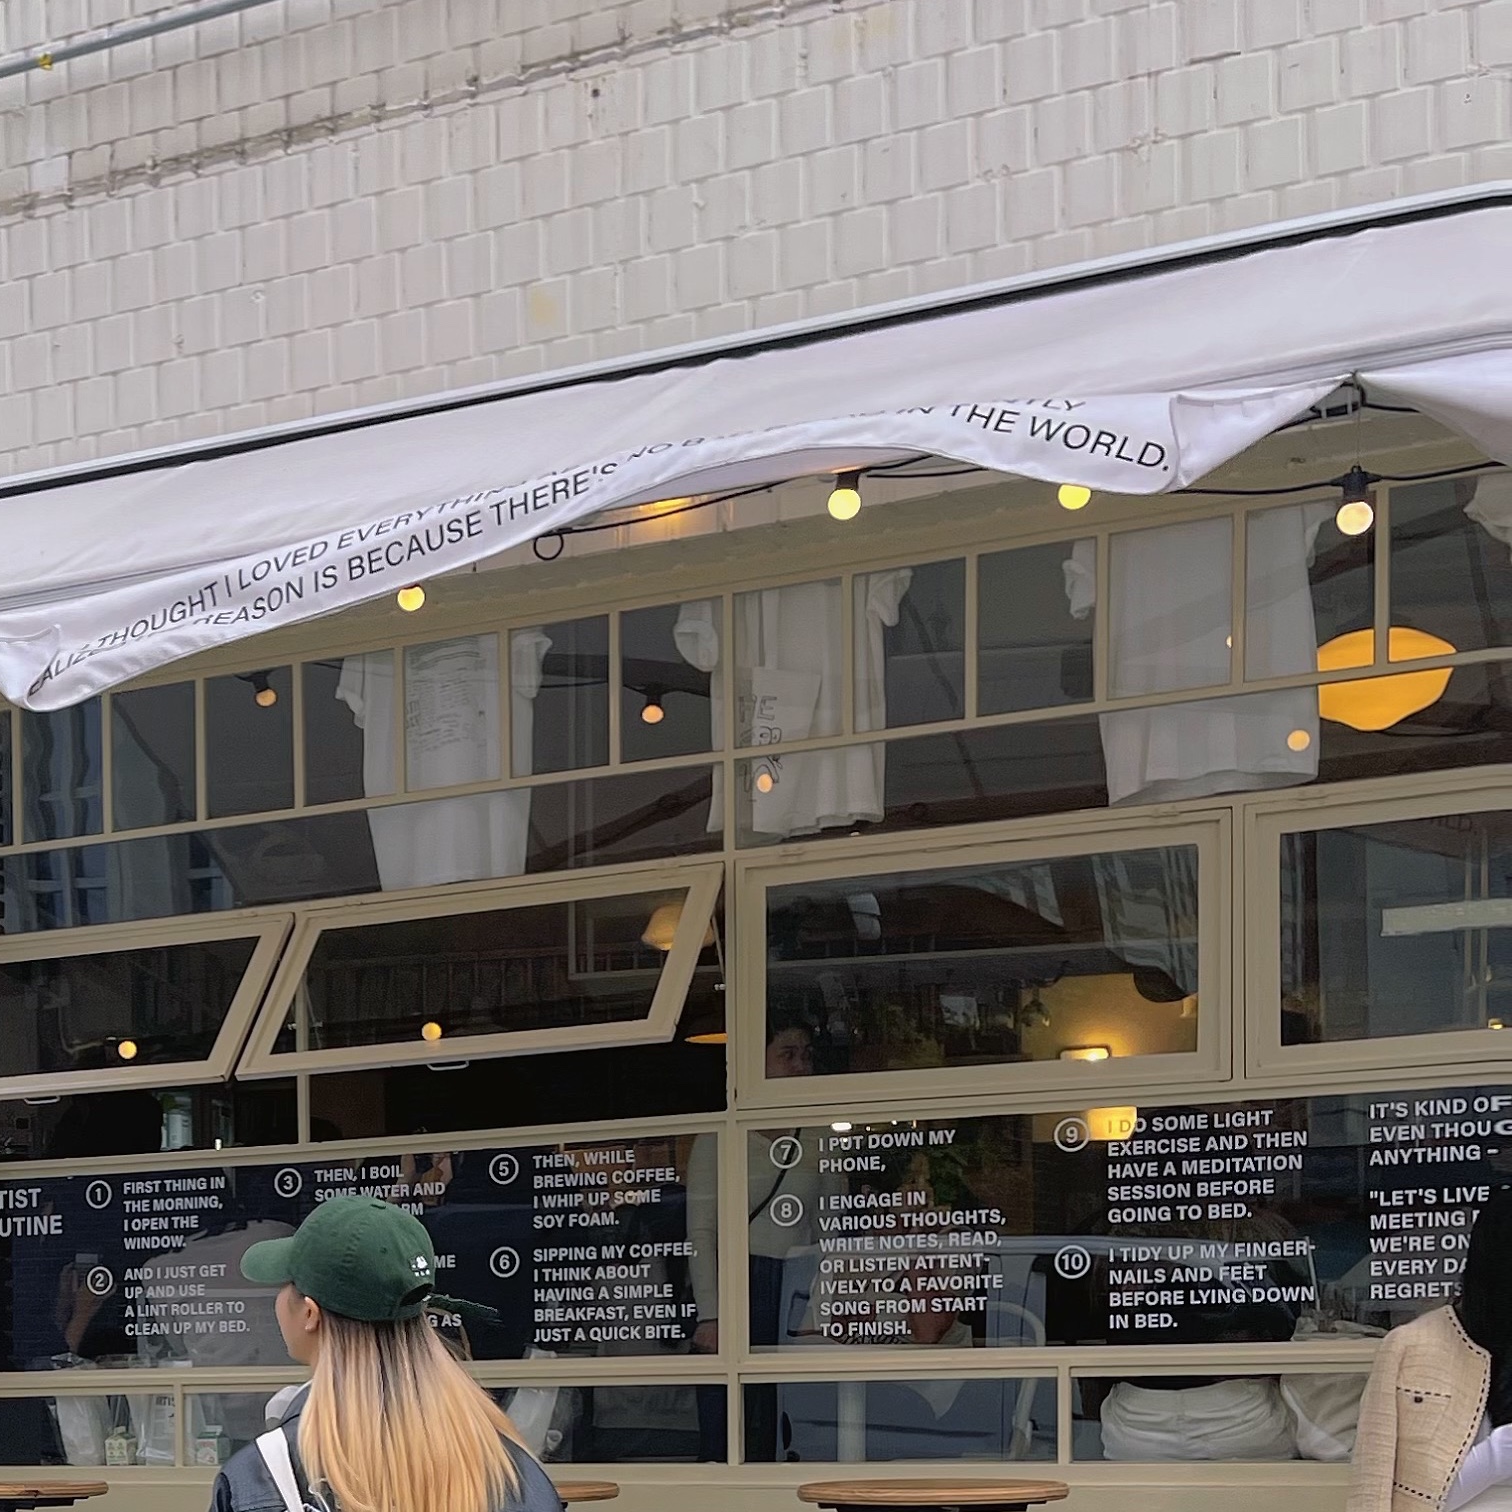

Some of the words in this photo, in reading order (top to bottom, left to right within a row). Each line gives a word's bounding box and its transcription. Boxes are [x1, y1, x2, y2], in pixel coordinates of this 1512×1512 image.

[193, 576, 304, 625] EASON
[314, 565, 338, 593] IS
[348, 510, 483, 582] BECAUSE
[949, 403, 1021, 434] THE
[1029, 415, 1169, 471] WORLD.
[97, 581, 218, 648] THOUGHT
[224, 574, 233, 598] I
[238, 540, 328, 590] LOVED
[1370, 1102, 1408, 1119] IT'S
[1415, 1099, 1467, 1117] KIND
[1473, 1095, 1512, 1112] OF
[1108, 1120, 1112, 1133] I
[1119, 1118, 1146, 1132] DO
[1152, 1115, 1208, 1131] SOME
[1214, 1110, 1273, 1128] LIGHT
[819, 1138, 823, 1151] I
[829, 1136, 863, 1150] PUT
[868, 1133, 924, 1148] DOWN
[929, 1130, 955, 1145] MY
[1370, 1124, 1425, 1143] EVEN
[1108, 1137, 1200, 1156] EXERCISE
[1205, 1135, 1248, 1151] AND
[1253, 1131, 1307, 1149] THEN
[532, 1153, 580, 1169] THEN,
[585, 1150, 635, 1166] WHILE
[819, 1156, 886, 1172] PHONE,
[1370, 1145, 1481, 1166] ANYTHING
[314, 1168, 358, 1182] THEN,
[362, 1167, 366, 1179] I
[370, 1165, 404, 1178] BOIL
[1108, 1162, 1158, 1179] HAVE
[1163, 1161, 1176, 1176] A
[1181, 1154, 1303, 1175] MEDITATION
[124, 1180, 161, 1195] FIRST
[164, 1178, 207, 1192] THING
[210, 1176, 225, 1189] IN
[534, 1172, 607, 1189] BREWING
[612, 1168, 680, 1183] COFFEE,
[360, 1184, 409, 1198] WATER
[414, 1182, 445, 1196] AND
[534, 1196, 538, 1208] I
[542, 1194, 583, 1208] WHIP
[588, 1192, 610, 1205] UP
[614, 1189, 661, 1204] SOME
[1108, 1183, 1191, 1201] SESSION
[1197, 1179, 1274, 1197] BEFORE
[1370, 1188, 1437, 1206] "LET'S
[1443, 1186, 1489, 1203] LIVE
[124, 1200, 150, 1213] THE
[153, 1196, 224, 1211] MORNING,
[819, 1197, 823, 1210] I
[830, 1193, 903, 1209] ENGAGE
[907, 1191, 926, 1205] IN
[533, 1215, 565, 1229] SOY
[569, 1212, 619, 1227] FOAM.
[819, 1214, 896, 1231] VARIOUS
[901, 1209, 1006, 1227] THOUGHTS,
[1108, 1206, 1171, 1223] GOING
[1177, 1205, 1202, 1220] TO
[1208, 1203, 1252, 1219] BED.
[1370, 1211, 1465, 1230] MEETING
[124, 1219, 128, 1231] I
[131, 1217, 168, 1230] OPEN
[172, 1216, 198, 1228] THE
[124, 1235, 186, 1250] WINDOW.
[819, 1236, 874, 1252] WRITE
[879, 1233, 943, 1250] NOTES,
[949, 1231, 1001, 1247] READ,
[1370, 1235, 1435, 1253] WE'RE
[533, 1247, 597, 1262] SIPPING
[602, 1245, 625, 1259] MY
[629, 1242, 697, 1258] COFFEE,
[1110, 1249, 1114, 1262] I
[1120, 1246, 1162, 1262] TIDY
[1168, 1245, 1193, 1260] UP
[1200, 1243, 1228, 1259] MY
[1234, 1241, 1315, 1257] FINGER-
[124, 1268, 154, 1281] AND
[157, 1267, 161, 1279] I
[164, 1265, 196, 1280] JUST
[200, 1264, 226, 1277] GET
[534, 1269, 538, 1282] I
[542, 1266, 591, 1281] THINK
[595, 1264, 651, 1280] ABOUT
[820, 1260, 844, 1274] OR
[849, 1257, 910, 1272] LISTEN
[915, 1253, 990, 1269] ATTENT-
[1370, 1258, 1437, 1276] EVERY
[1110, 1268, 1166, 1284] NAILS
[1171, 1268, 1213, 1282] AND
[1219, 1265, 1267, 1281] FEET
[125, 1286, 142, 1300] UP
[146, 1284, 174, 1298] AND
[179, 1284, 205, 1297] USE
[534, 1287, 594, 1302] HAVING
[598, 1286, 609, 1299] A
[613, 1284, 673, 1298] SIMPLE
[820, 1278, 868, 1294] IVELY
[871, 1277, 895, 1292] TO
[900, 1278, 912, 1292] A
[917, 1275, 1003, 1291] FAVORITE
[1110, 1290, 1184, 1307] BEFORE
[1190, 1289, 1246, 1304] LYING
[1252, 1286, 1314, 1303] DOWN
[125, 1304, 134, 1318] A
[138, 1303, 168, 1317] LINT
[171, 1302, 223, 1316] ROLLER
[226, 1301, 245, 1314] TO
[534, 1306, 629, 1322] BREAKFAST,
[634, 1304, 676, 1319] EVEN
[681, 1304, 696, 1317] IF
[820, 1301, 870, 1316] SONG
[875, 1299, 926, 1313] FROM
[931, 1297, 987, 1312] START
[125, 1322, 169, 1336] CLEAN
[173, 1321, 191, 1334] UP
[196, 1321, 216, 1334] MY
[220, 1320, 250, 1332] BED.
[441, 1314, 462, 1327] AS
[820, 1322, 843, 1337] TO
[848, 1320, 911, 1336] FINISH.
[1110, 1314, 1129, 1329] IN
[1135, 1313, 1178, 1328] BED.
[534, 1328, 571, 1342] JUST
[574, 1327, 585, 1340] A
[590, 1326, 640, 1341] QUICK
[645, 1325, 686, 1339] BITE.
